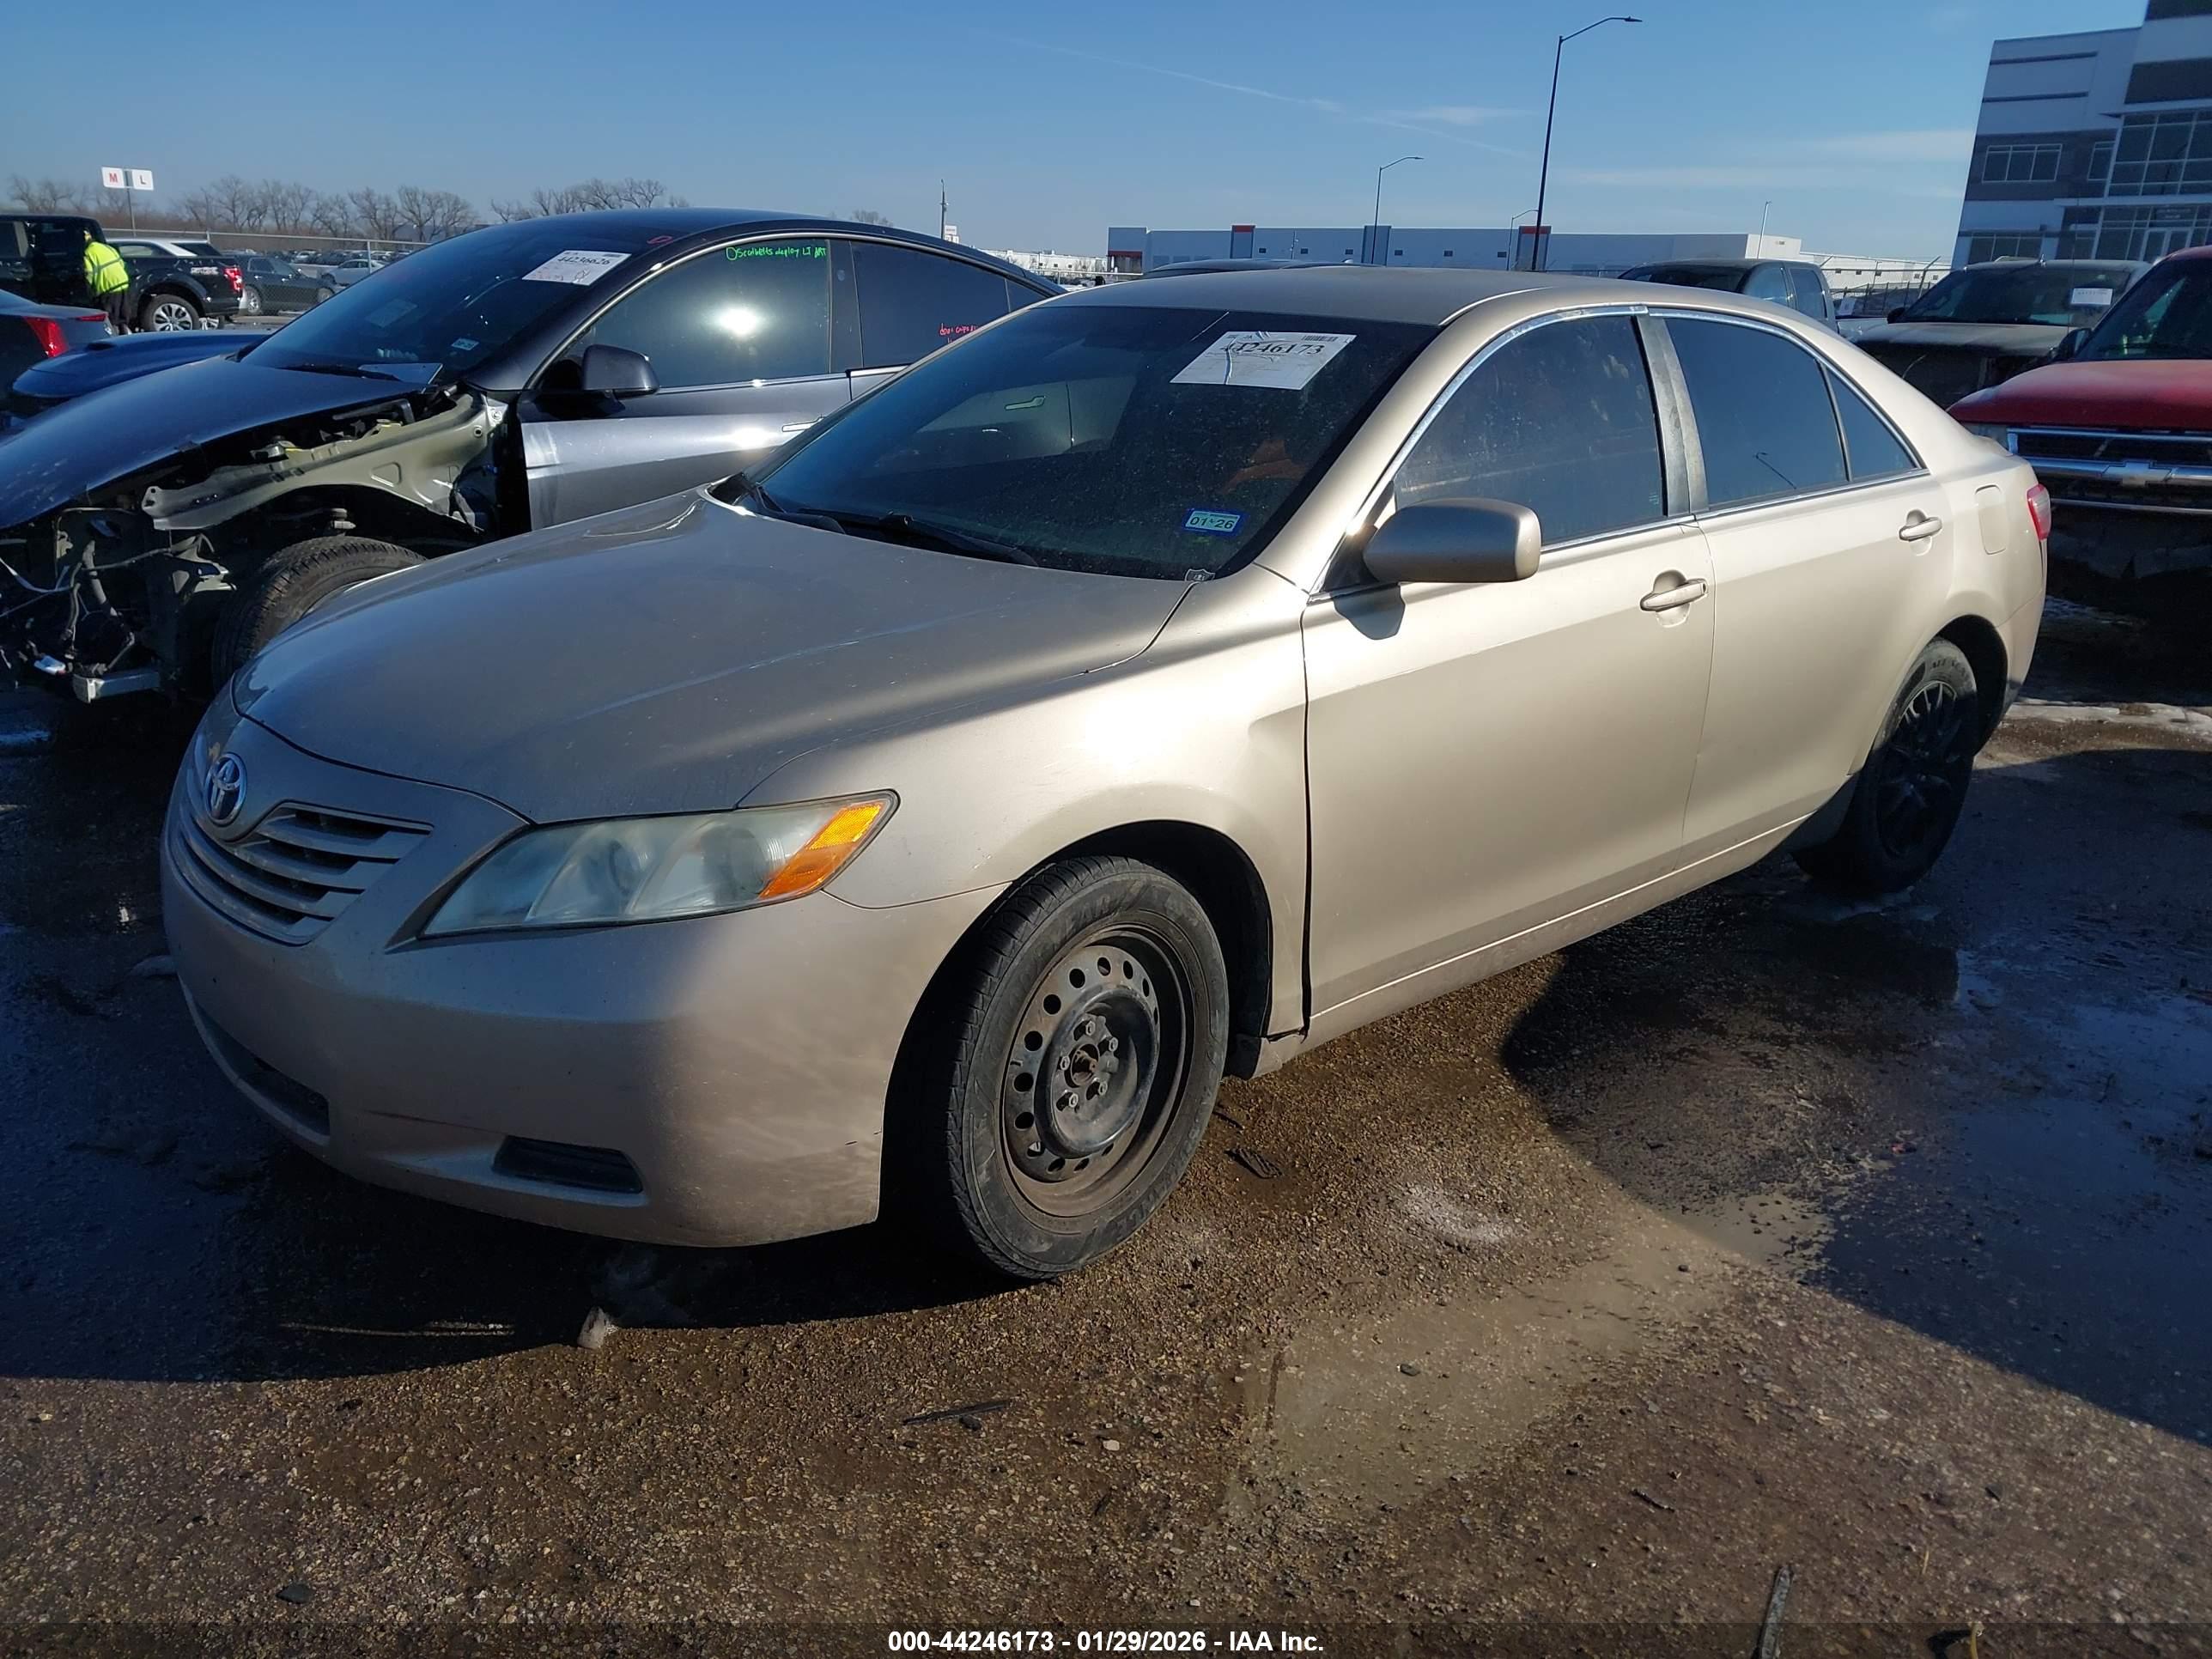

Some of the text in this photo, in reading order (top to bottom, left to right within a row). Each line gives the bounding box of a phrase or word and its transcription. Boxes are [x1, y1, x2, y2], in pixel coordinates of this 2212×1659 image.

[109, 173, 118, 183] M
[140, 175, 147, 185] L
[1219, 341, 1326, 356] 44246173
